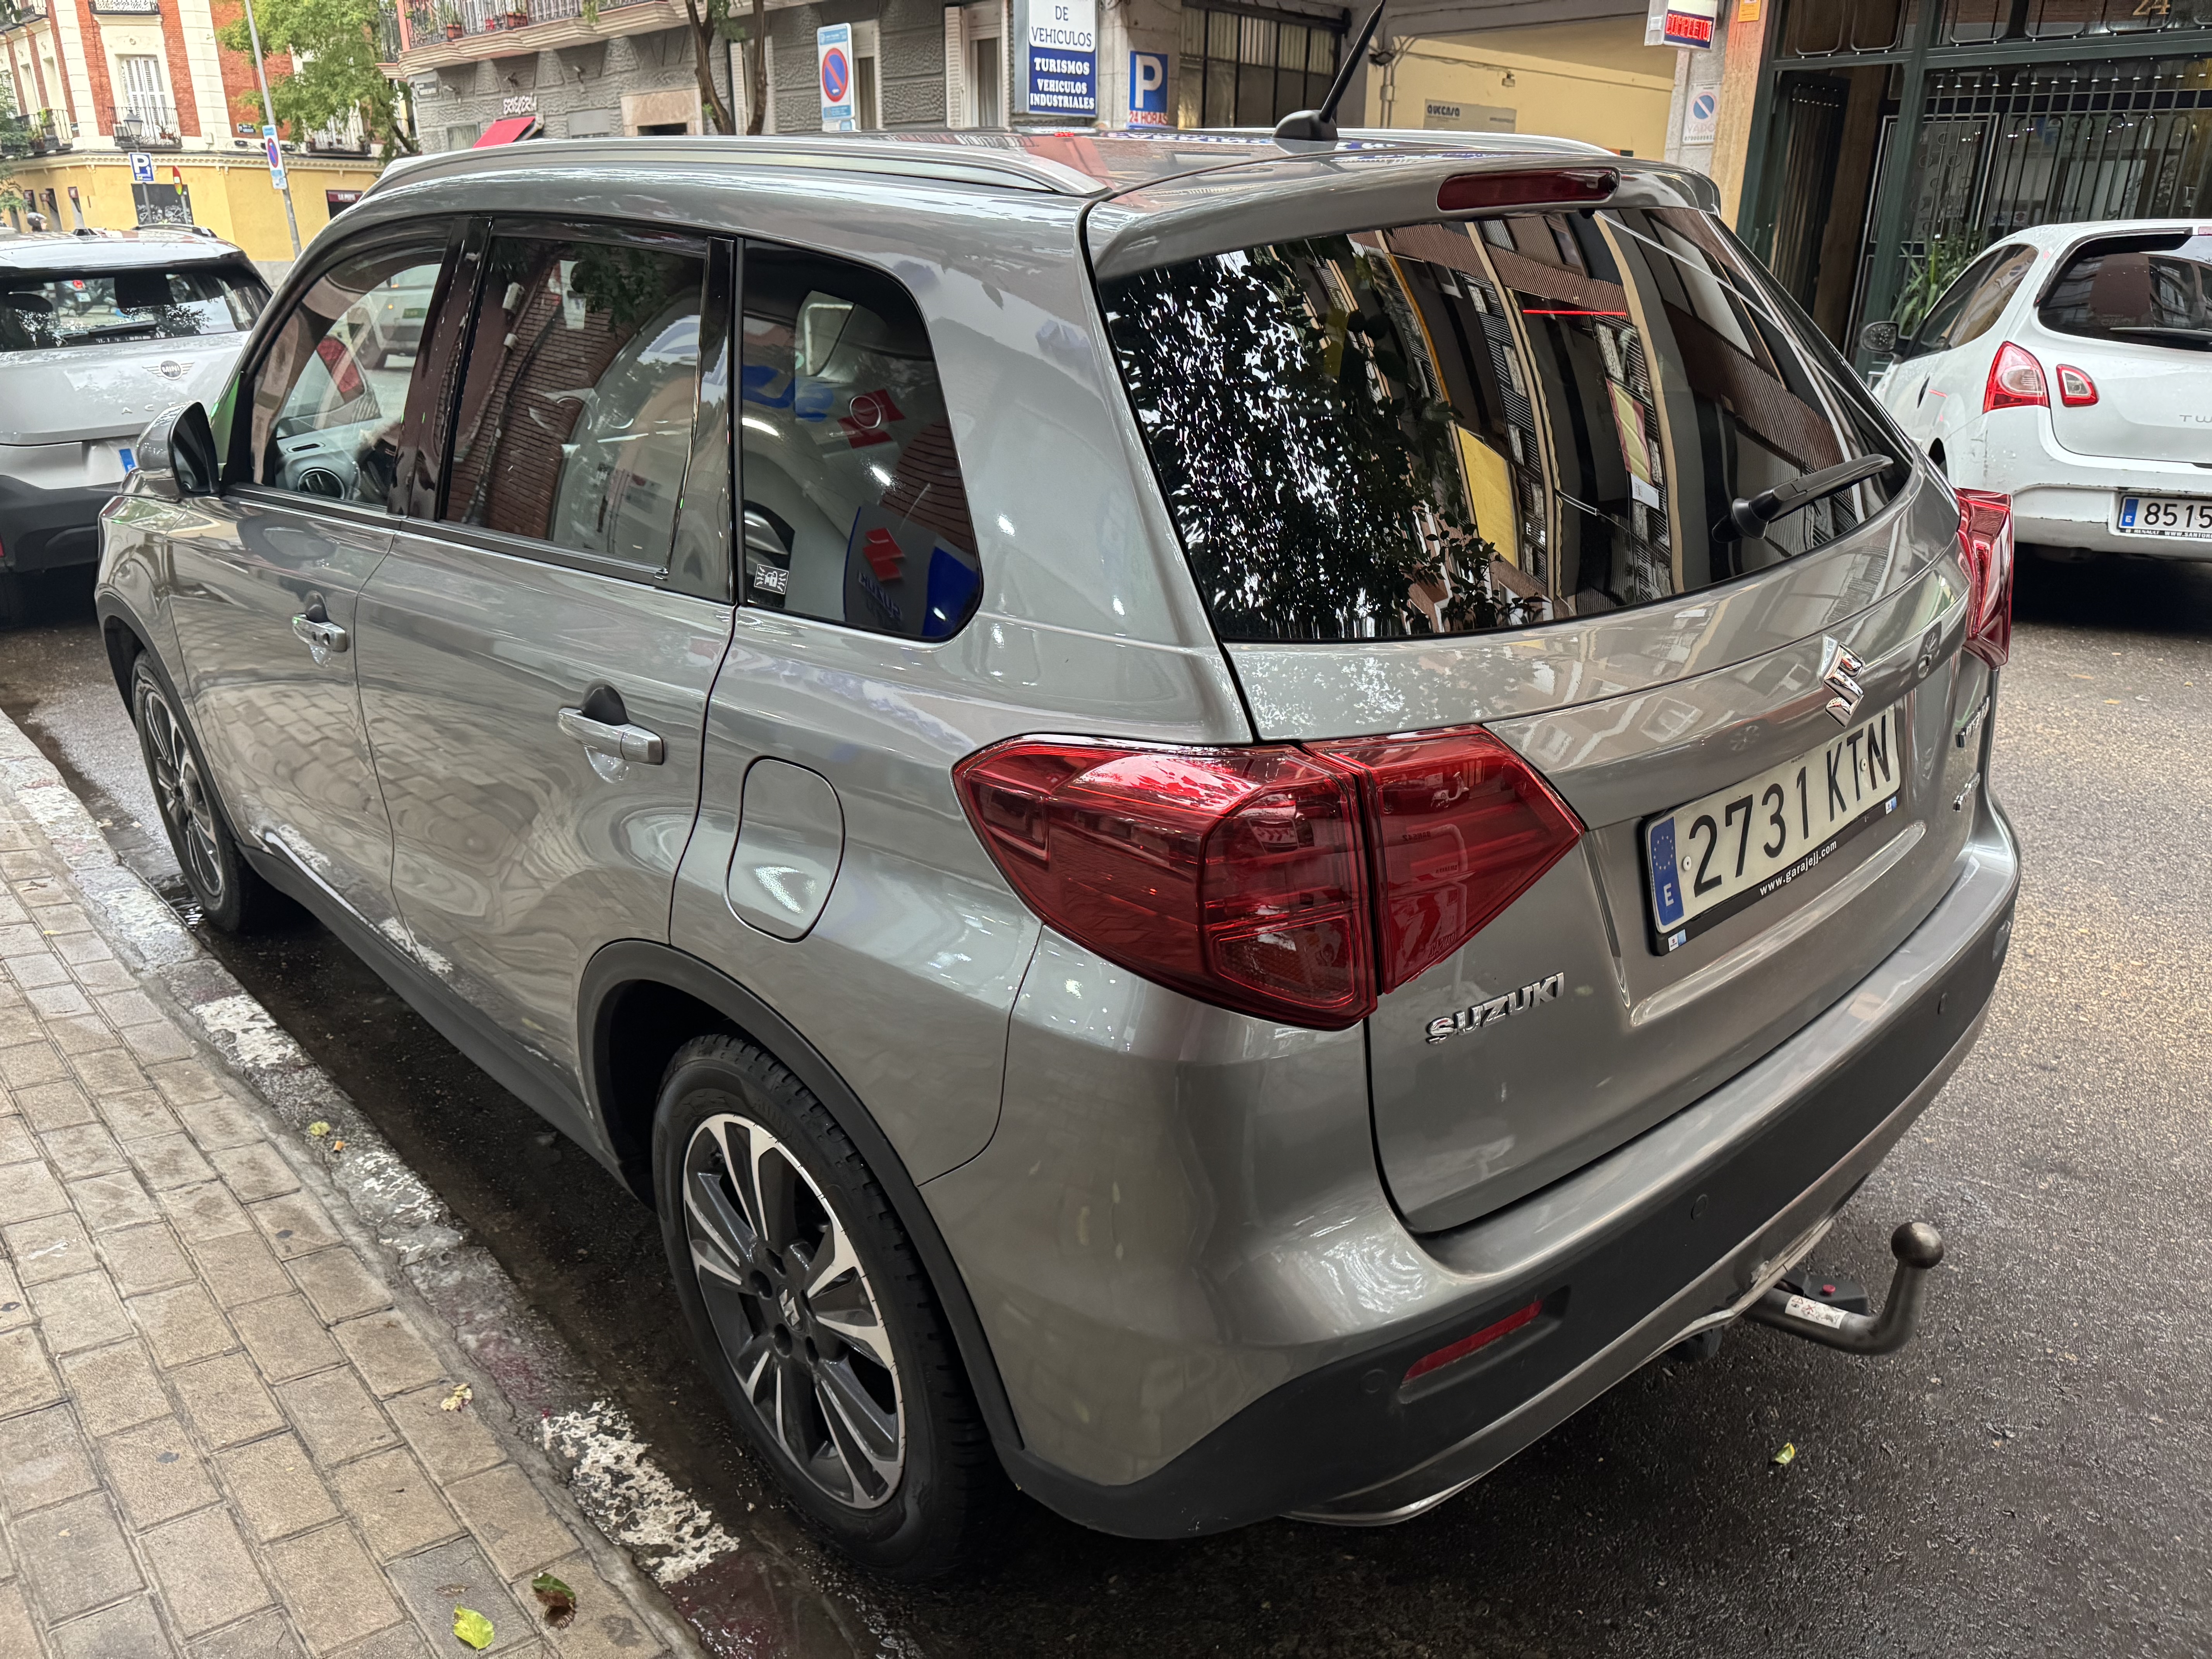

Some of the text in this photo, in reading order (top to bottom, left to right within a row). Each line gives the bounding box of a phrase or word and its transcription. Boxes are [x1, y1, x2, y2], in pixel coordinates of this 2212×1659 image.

[1055, 5, 1068, 21] DE
[1031, 26, 1091, 47] VEHICULOS
[1666, 13, 1712, 42] COMPLETO
[1034, 57, 1090, 75] TURISMOS
[1037, 79, 1087, 94] VEHICULOS
[1135, 55, 1163, 108] P
[1030, 93, 1094, 109] INDUSTRIALES
[1130, 111, 1168, 125] 24 HORAS
[132, 155, 149, 173] P
[2144, 503, 2212, 529] 8515
[1663, 883, 1674, 907] E
[1688, 766, 1808, 898] 2731
[1826, 715, 1891, 822] KTN
[1760, 841, 1837, 896] www.garajejj.com
[1426, 972, 1564, 1045] SUZUKI
